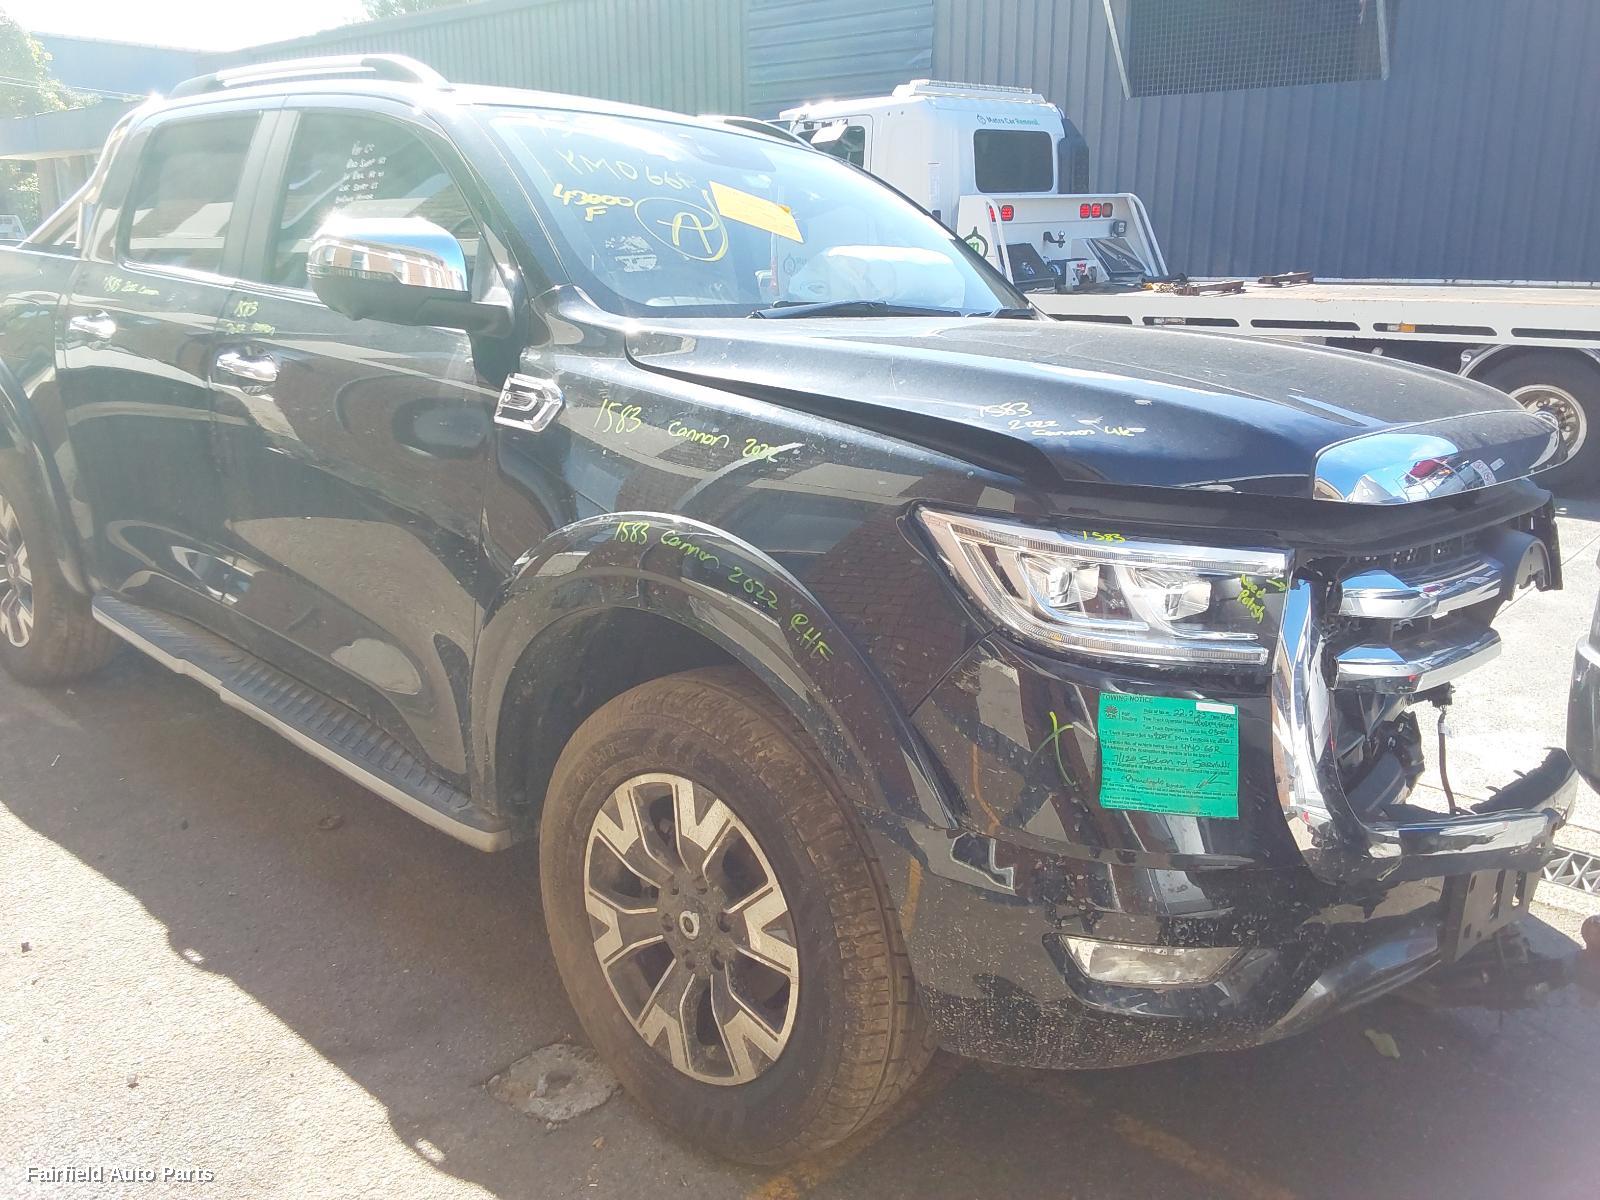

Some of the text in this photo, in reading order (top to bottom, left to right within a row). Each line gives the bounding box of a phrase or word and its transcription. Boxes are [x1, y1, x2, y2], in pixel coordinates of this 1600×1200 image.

[593, 398, 642, 433] 1583
[667, 421, 730, 449] Cannon
[1082, 530, 1127, 543] 1583
[613, 521, 650, 544] 1583
[660, 529, 720, 569] Cannon
[727, 565, 779, 610] 2022
[1102, 694, 1154, 704] TOWING NOTICE
